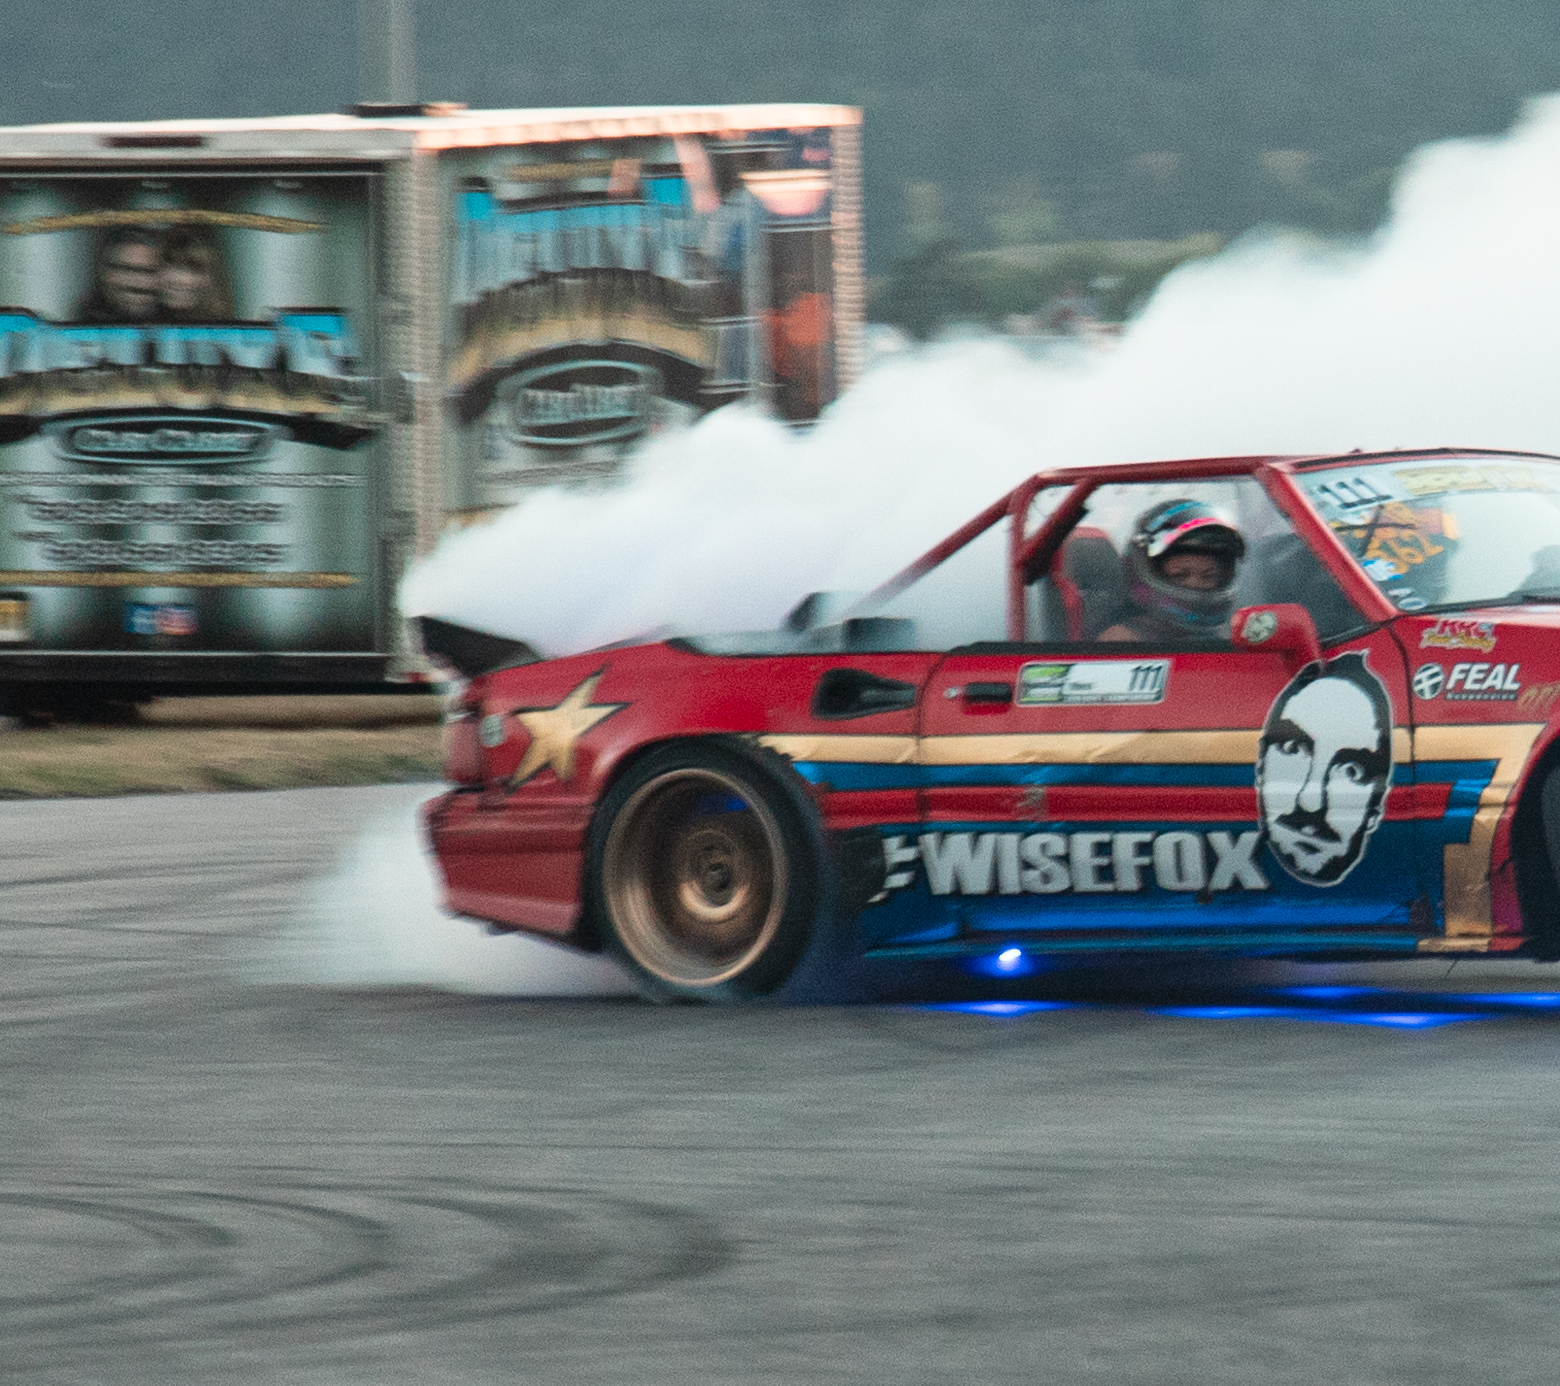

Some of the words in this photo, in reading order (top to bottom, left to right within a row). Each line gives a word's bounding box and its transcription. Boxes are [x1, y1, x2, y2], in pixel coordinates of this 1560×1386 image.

[1319, 475, 1395, 510] 111
[1128, 665, 1163, 692] 111
[1445, 662, 1521, 690] FEAL
